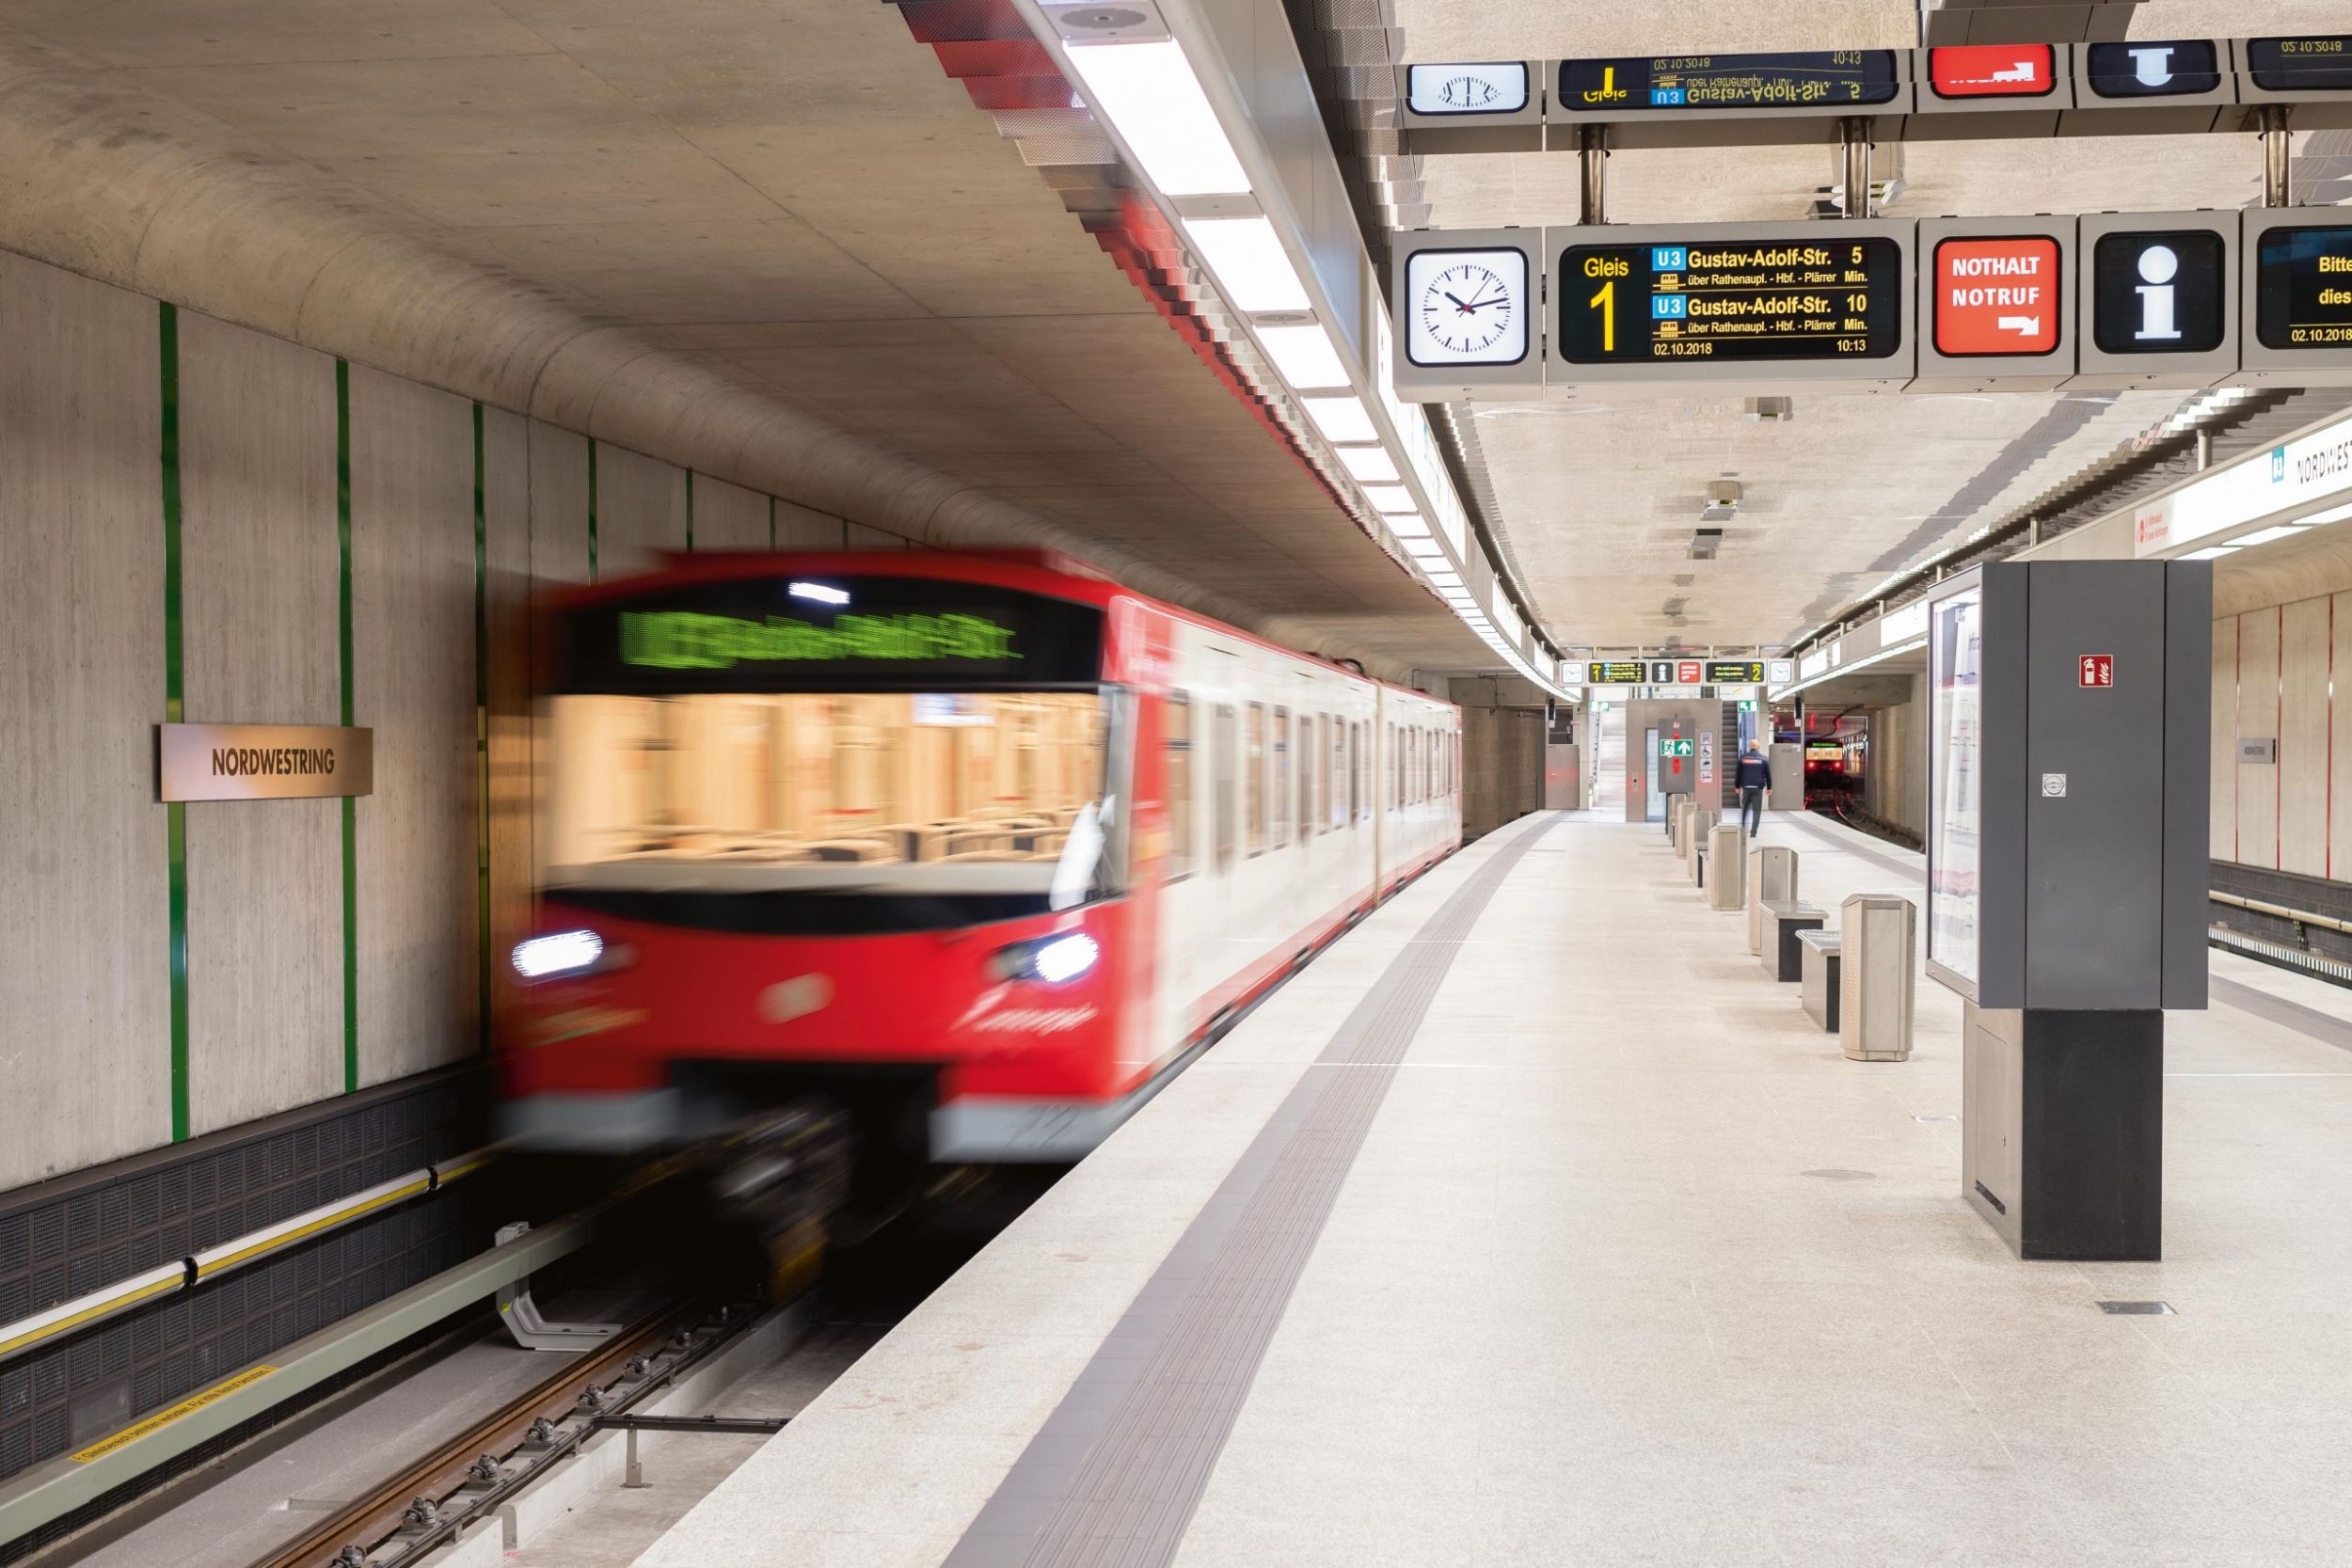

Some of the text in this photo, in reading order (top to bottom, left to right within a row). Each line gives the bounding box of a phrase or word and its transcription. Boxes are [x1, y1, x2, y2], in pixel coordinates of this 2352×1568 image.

[1689, 248, 1831, 267] Gustav-Adolf-Str.
[1852, 246, 1862, 263] 5
[1585, 258, 1629, 277] Gleis
[1953, 257, 2040, 276] NOTHALT
[1689, 275, 1709, 285] über
[1711, 274, 1767, 286] Rathenaupl.
[1776, 273, 1795, 283] Hbf.
[1804, 272, 1836, 282] Plärrer
[1845, 271, 1867, 282] Min.
[1689, 296, 1831, 315] Gustav-Adolf-Str.
[1848, 294, 1867, 311] 10
[1953, 288, 2039, 306] NOTRUF
[1591, 282, 1613, 351] 1
[1688, 323, 1709, 333] über
[1711, 322, 1767, 334] Rathenaupl.
[1776, 321, 1795, 331] Hbf.
[1804, 320, 1836, 330] Plärrer
[1845, 319, 1867, 330] Min.
[2292, 329, 2352, 341] 02.10.2018
[1655, 340, 1866, 355] 02.10.2018 10:13
[2297, 439, 2352, 485] NORDWES
[212, 748, 335, 776] NORDWESTRING
